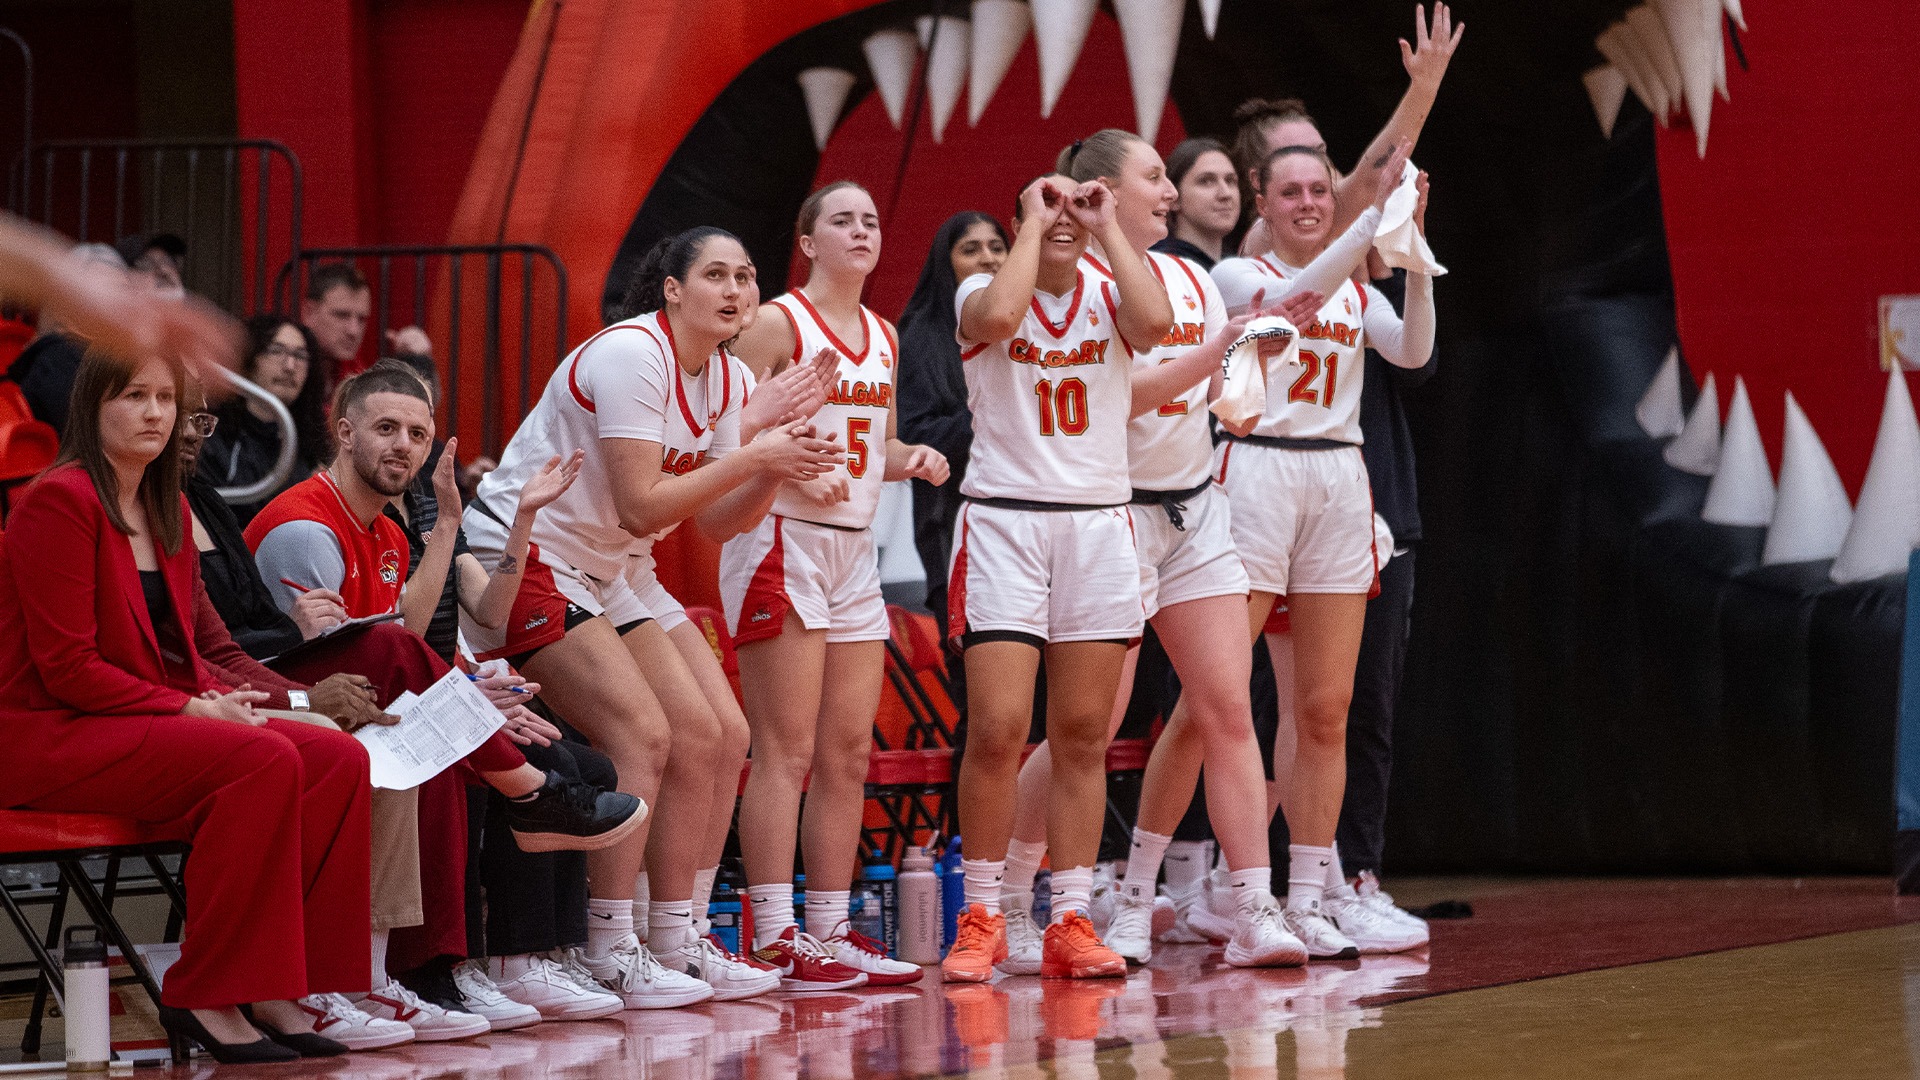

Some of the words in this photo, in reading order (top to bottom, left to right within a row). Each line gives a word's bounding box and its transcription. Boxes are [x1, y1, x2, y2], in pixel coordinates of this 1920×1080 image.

[1035, 377, 1089, 436] 10
[1288, 349, 1338, 409] 21
[847, 417, 871, 479] 5
[525, 616, 549, 630] DINOS
